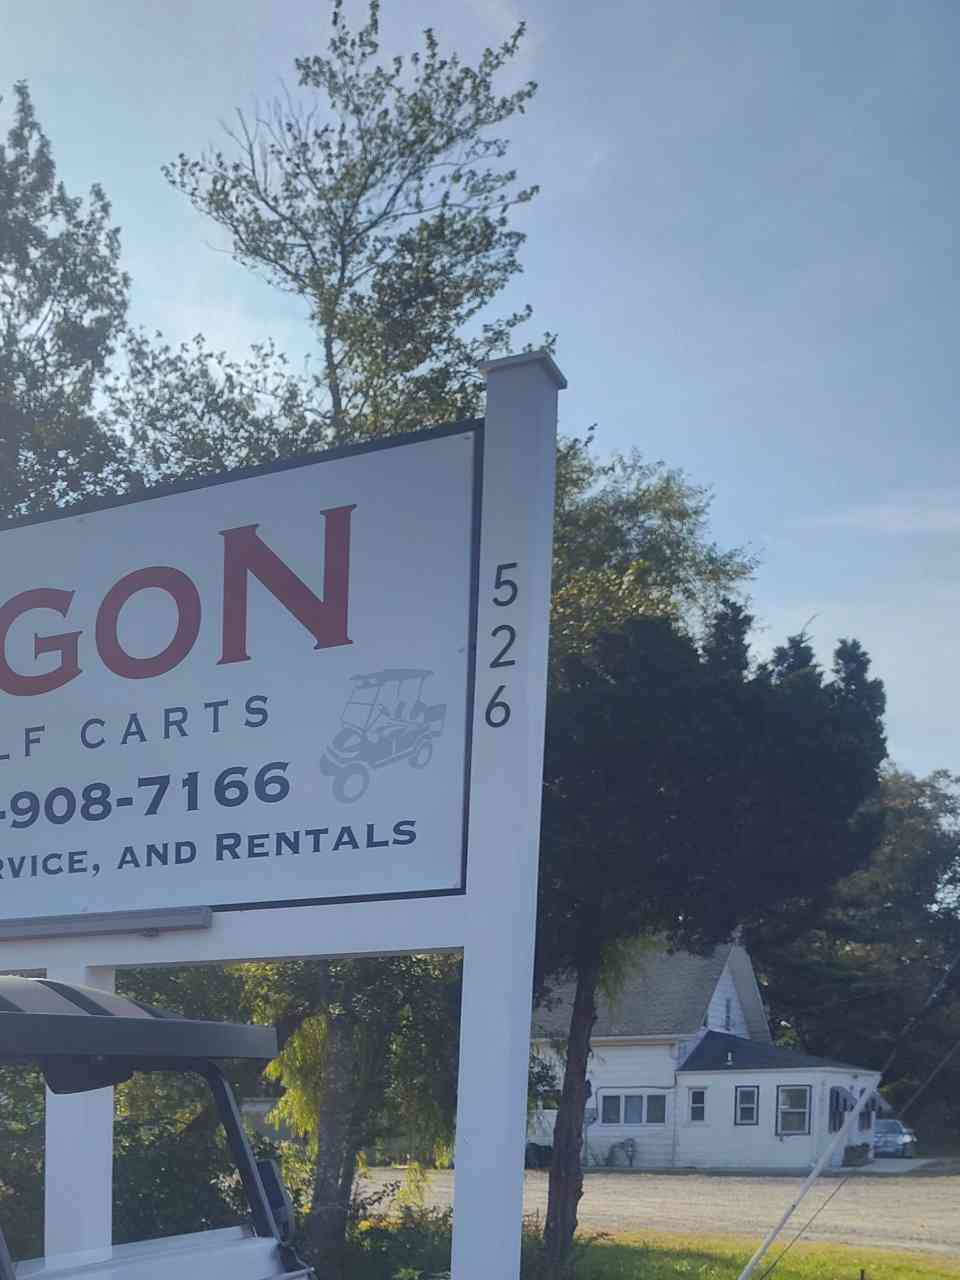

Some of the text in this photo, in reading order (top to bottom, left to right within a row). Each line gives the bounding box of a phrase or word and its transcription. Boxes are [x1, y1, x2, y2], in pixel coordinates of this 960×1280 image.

[80, 695, 269, 749] CARTS
[116, 840, 197, 869] AND
[215, 820, 417, 861] RENTALS
